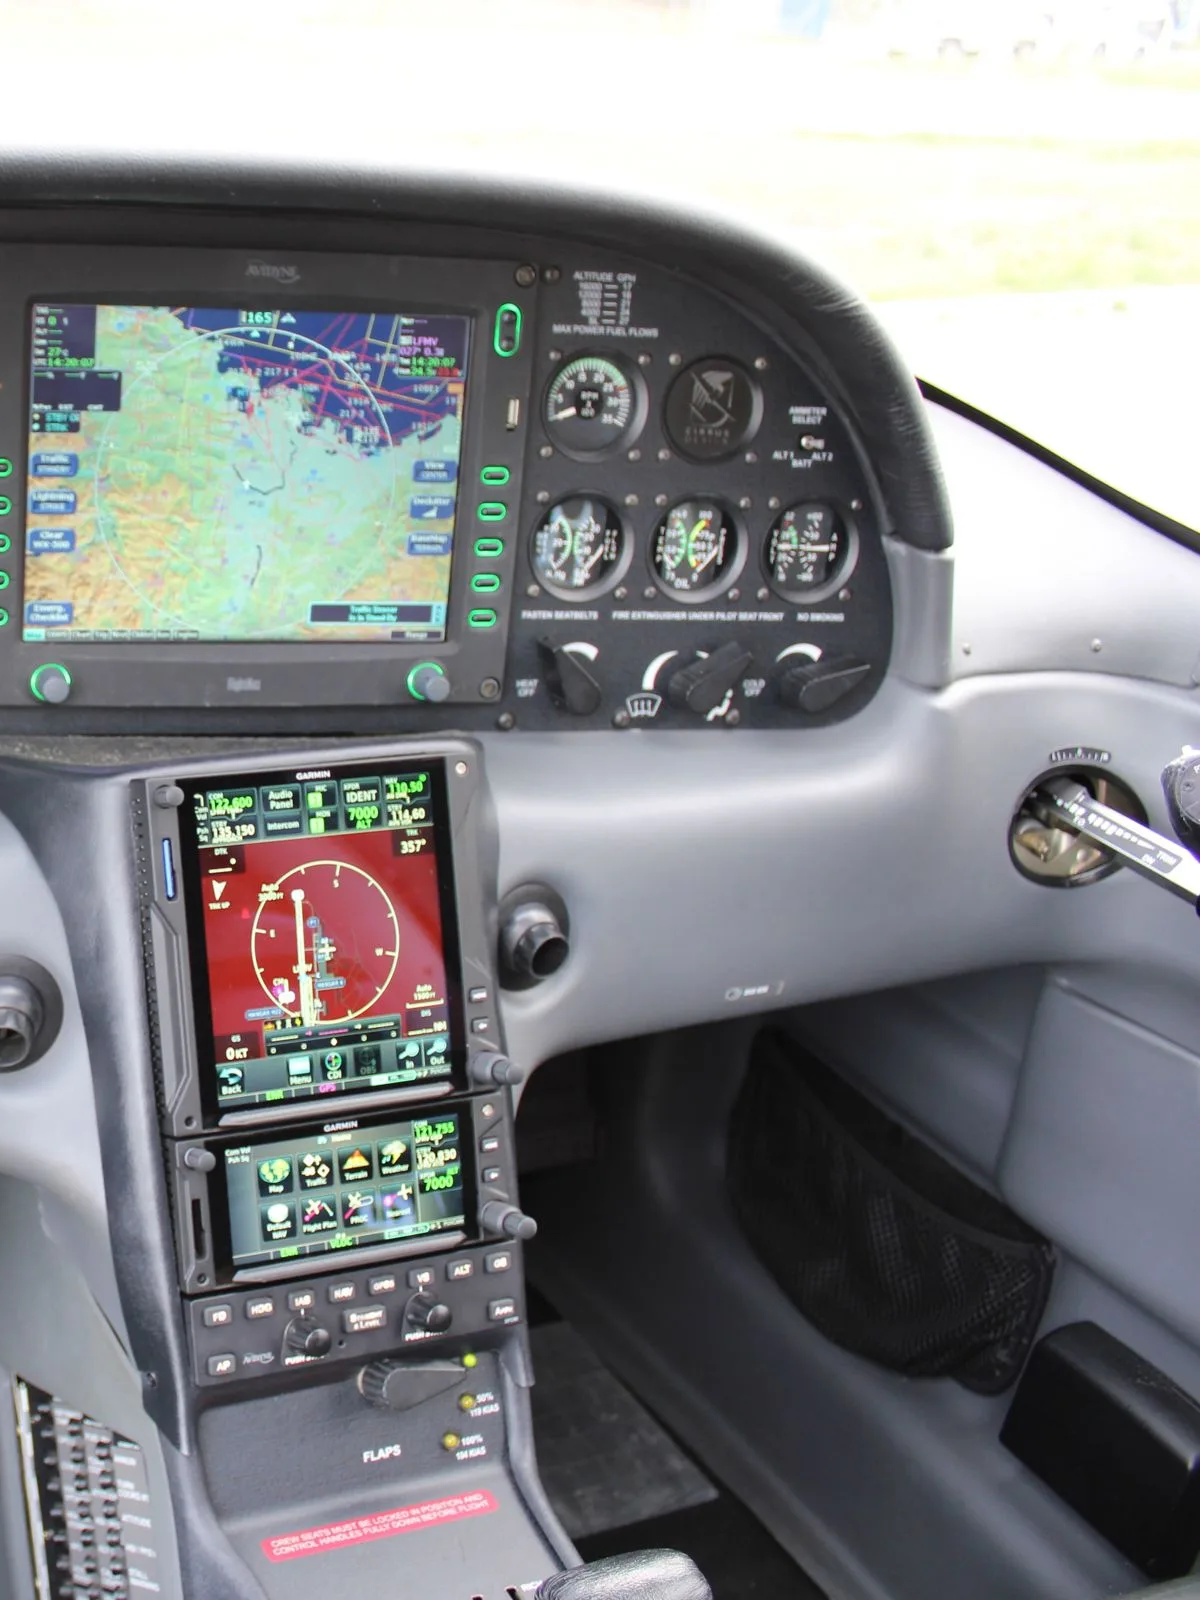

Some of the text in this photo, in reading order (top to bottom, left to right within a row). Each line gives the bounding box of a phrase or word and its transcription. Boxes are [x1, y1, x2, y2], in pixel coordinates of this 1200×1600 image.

[296, 770, 331, 780] GARMIN
[388, 780, 424, 794] 110.50
[268, 790, 294, 800] Audio
[346, 790, 378, 803] IDENT
[210, 796, 253, 810] 122.600
[270, 800, 294, 810] Panel
[348, 806, 379, 821] 7000
[267, 821, 300, 830] Intercom
[356, 819, 372, 829] ALT
[212, 824, 256, 838] 135.150
[333, 879, 340, 888] S
[430, 1056, 445, 1065] Out
[327, 1070, 342, 1080] CDI
[221, 1084, 242, 1095] Back
[319, 1083, 336, 1093] GPS
[324, 1120, 358, 1133] GARMIN
[382, 1164, 409, 1175] Weather
[344, 1170, 368, 1181] Terrain
[304, 1178, 328, 1188] Traffic
[424, 1176, 454, 1191] 7000
[268, 1184, 284, 1194] Map
[454, 1264, 472, 1276] ALT
[216, 1360, 232, 1372] AP
[476, 1392, 494, 1403] 50%
[482, 1403, 500, 1414] KIAS
[461, 1434, 484, 1446] 100%
[362, 1444, 402, 1463] FLAPS
[468, 1446, 487, 1458] KIAS
[270, 1493, 484, 1548] CREW SEATS MUST BE LOCKED IN POSITION AND
[272, 1500, 490, 1557] CONTROL HANDLES FULLY DOWN BEFORE FLIGHT
